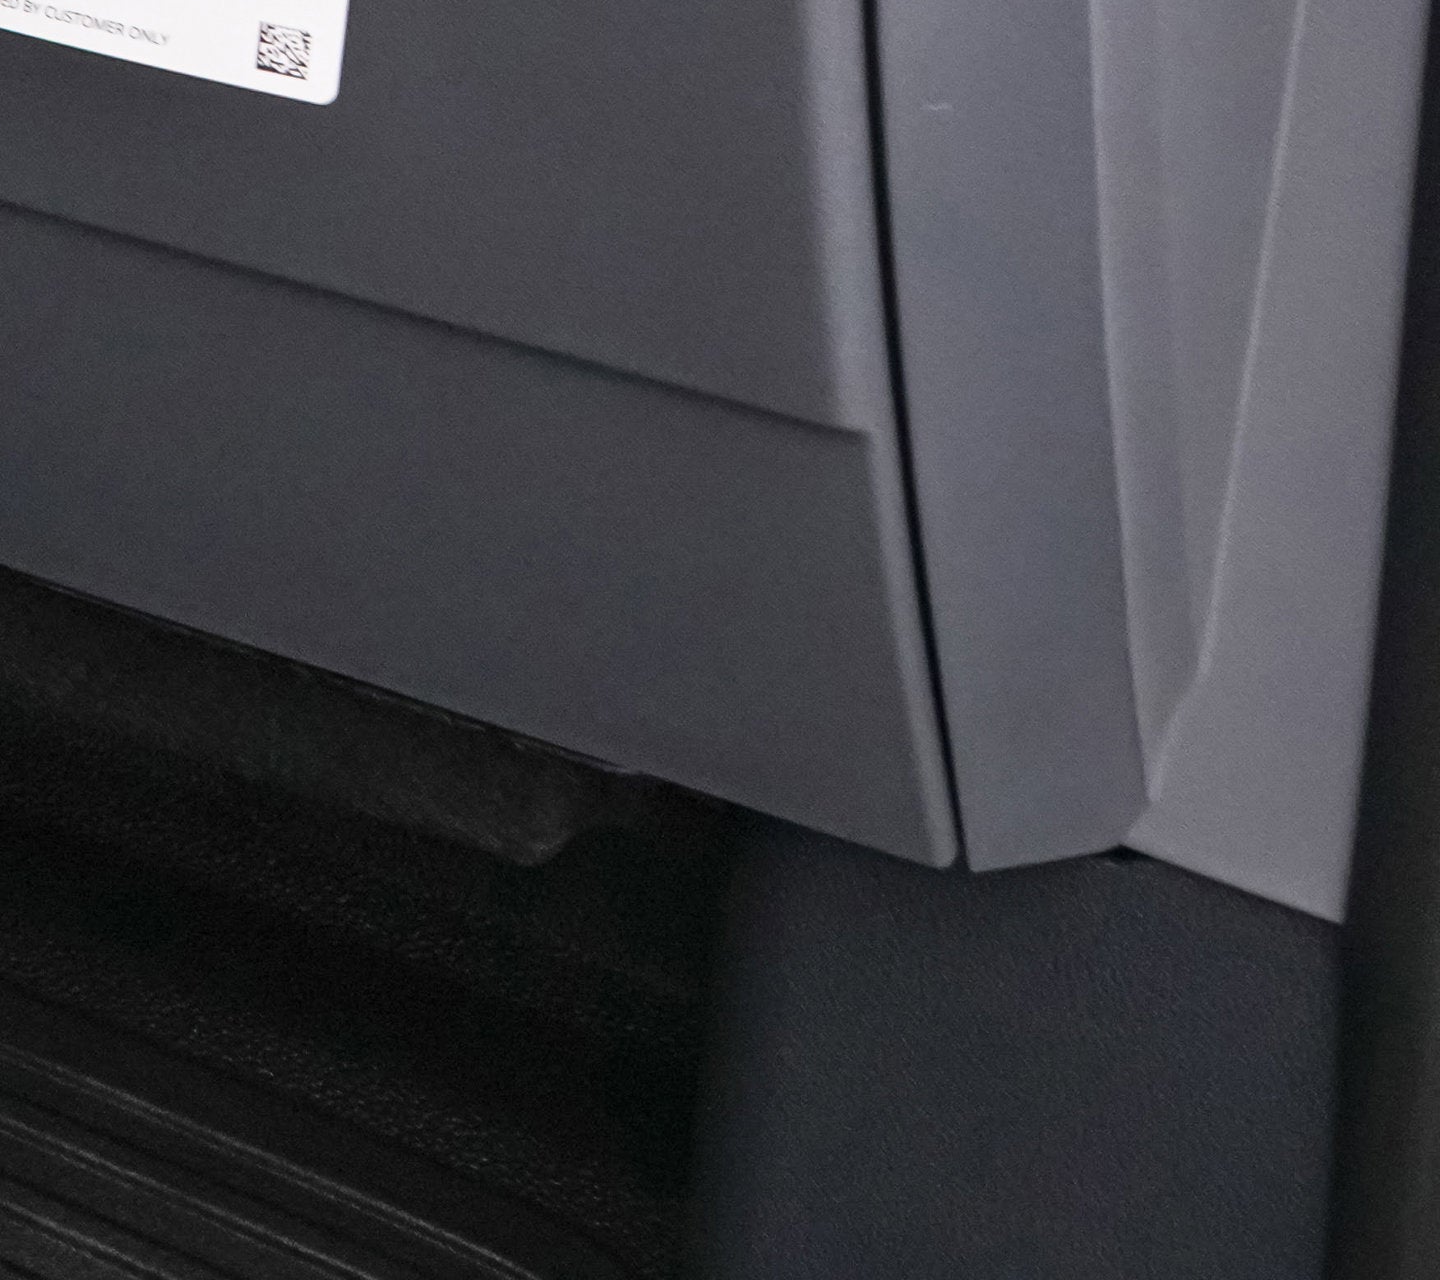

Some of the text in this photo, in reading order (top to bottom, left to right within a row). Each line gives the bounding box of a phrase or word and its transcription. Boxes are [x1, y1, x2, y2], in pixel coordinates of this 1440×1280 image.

[23, 0, 40, 14] BY
[44, 5, 125, 36] CUSTOMER
[128, 26, 171, 46] ONLY
